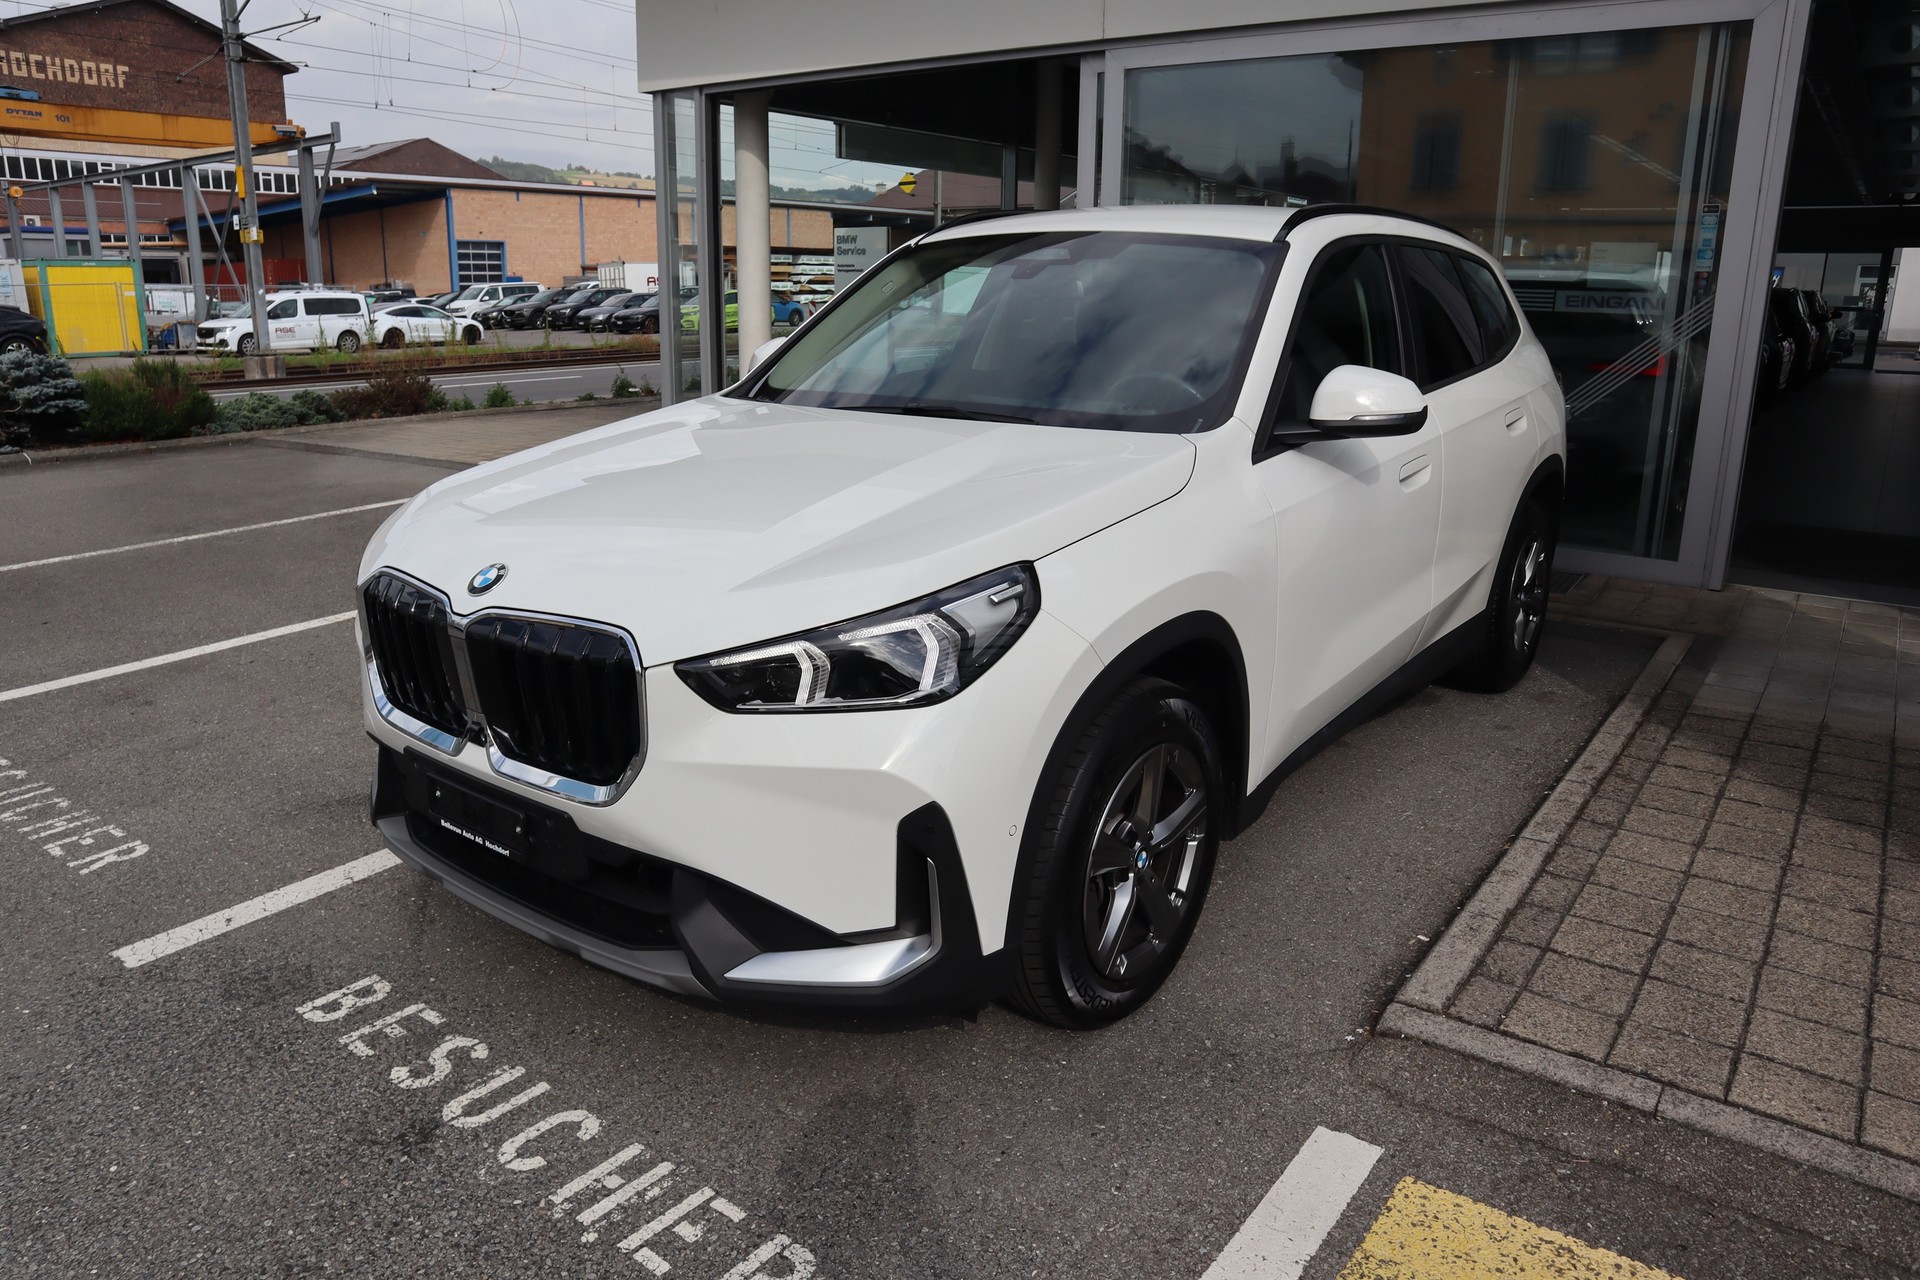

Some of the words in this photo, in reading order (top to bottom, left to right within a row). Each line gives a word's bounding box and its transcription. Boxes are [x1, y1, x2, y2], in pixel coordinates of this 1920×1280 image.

[54, 114, 72, 123] 10t
[836, 235, 858, 245] BMW
[836, 246, 867, 256] Service
[440, 818, 462, 834] Bellevue
[462, 829, 475, 841] Auto
[475, 835, 484, 844] AG
[485, 840, 510, 857] Hochdorf
[295, 973, 817, 1280] BESUCHER
